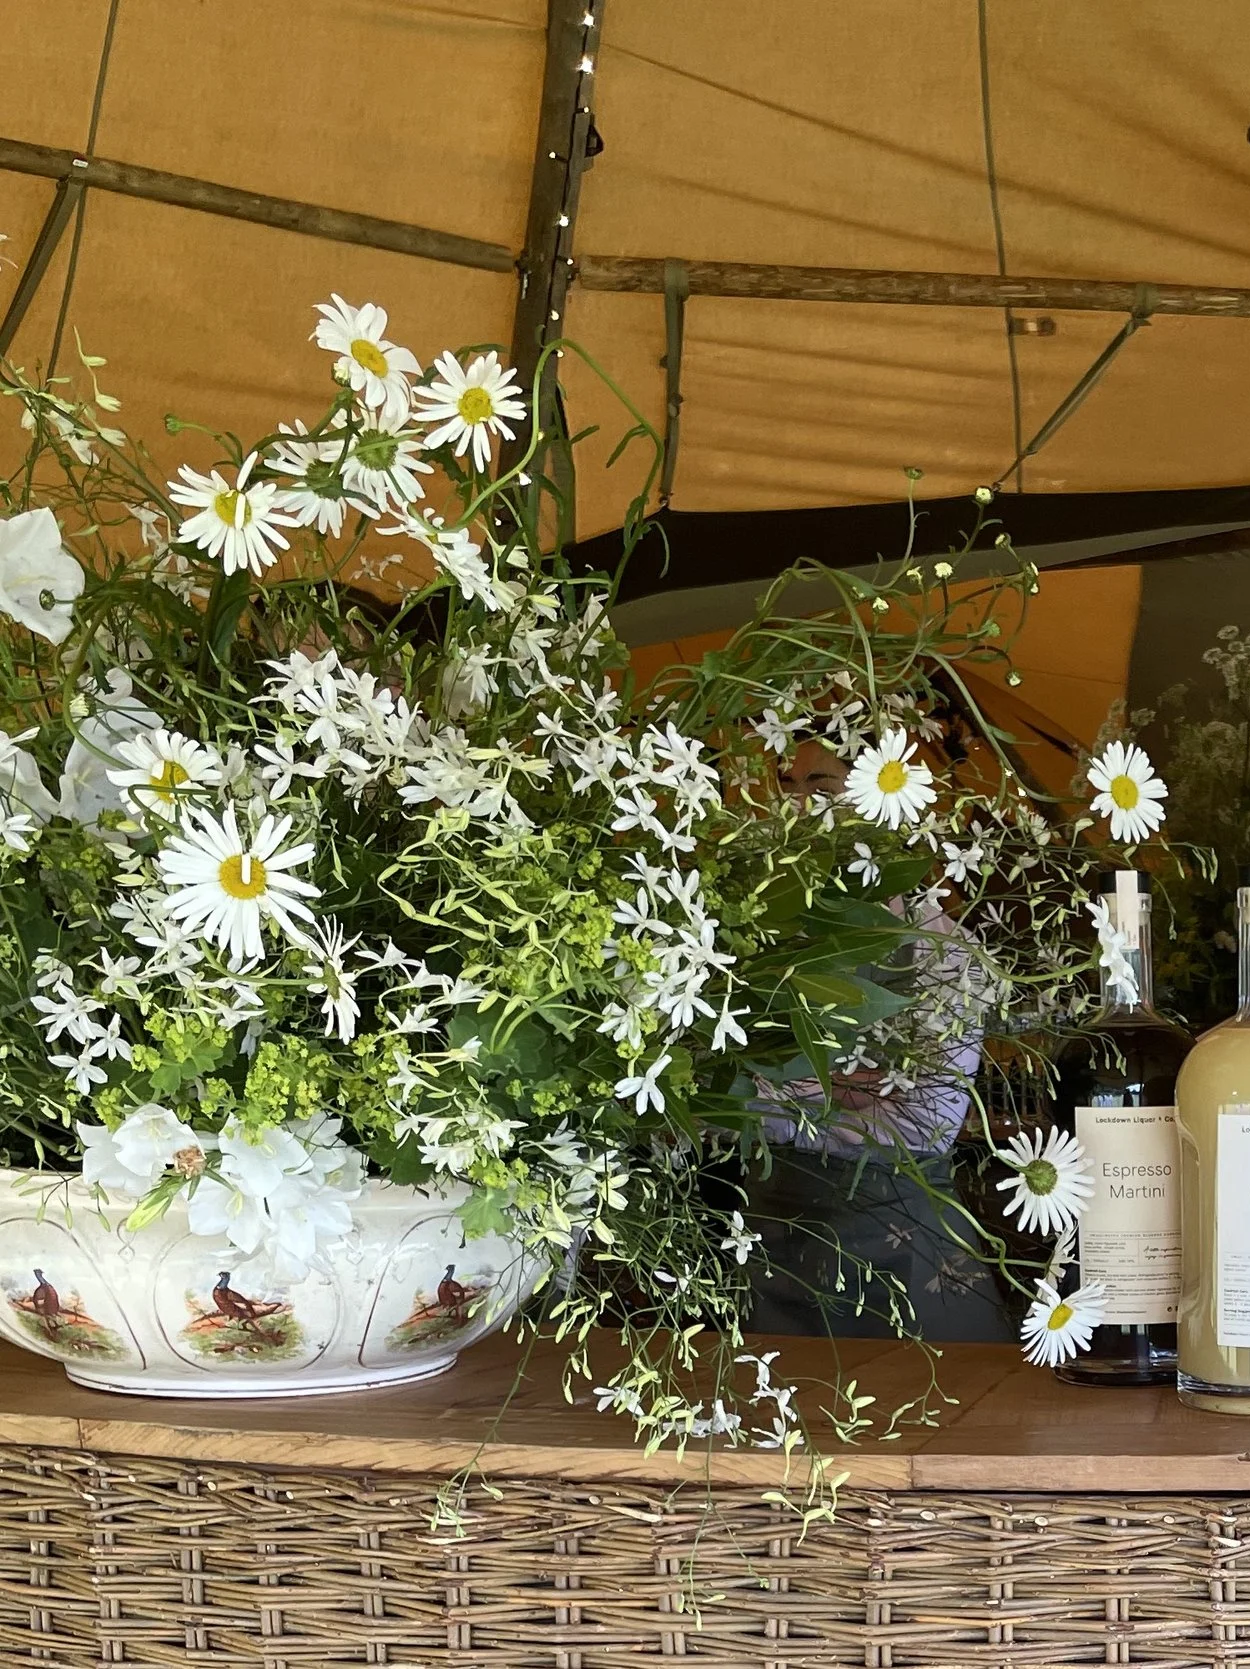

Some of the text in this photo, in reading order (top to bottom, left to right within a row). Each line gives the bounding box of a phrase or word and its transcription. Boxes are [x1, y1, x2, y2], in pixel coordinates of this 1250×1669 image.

[1095, 1116, 1131, 1124] Lockdown
[1102, 1162, 1172, 1180] Espresso
[1110, 1184, 1165, 1199] Martini
